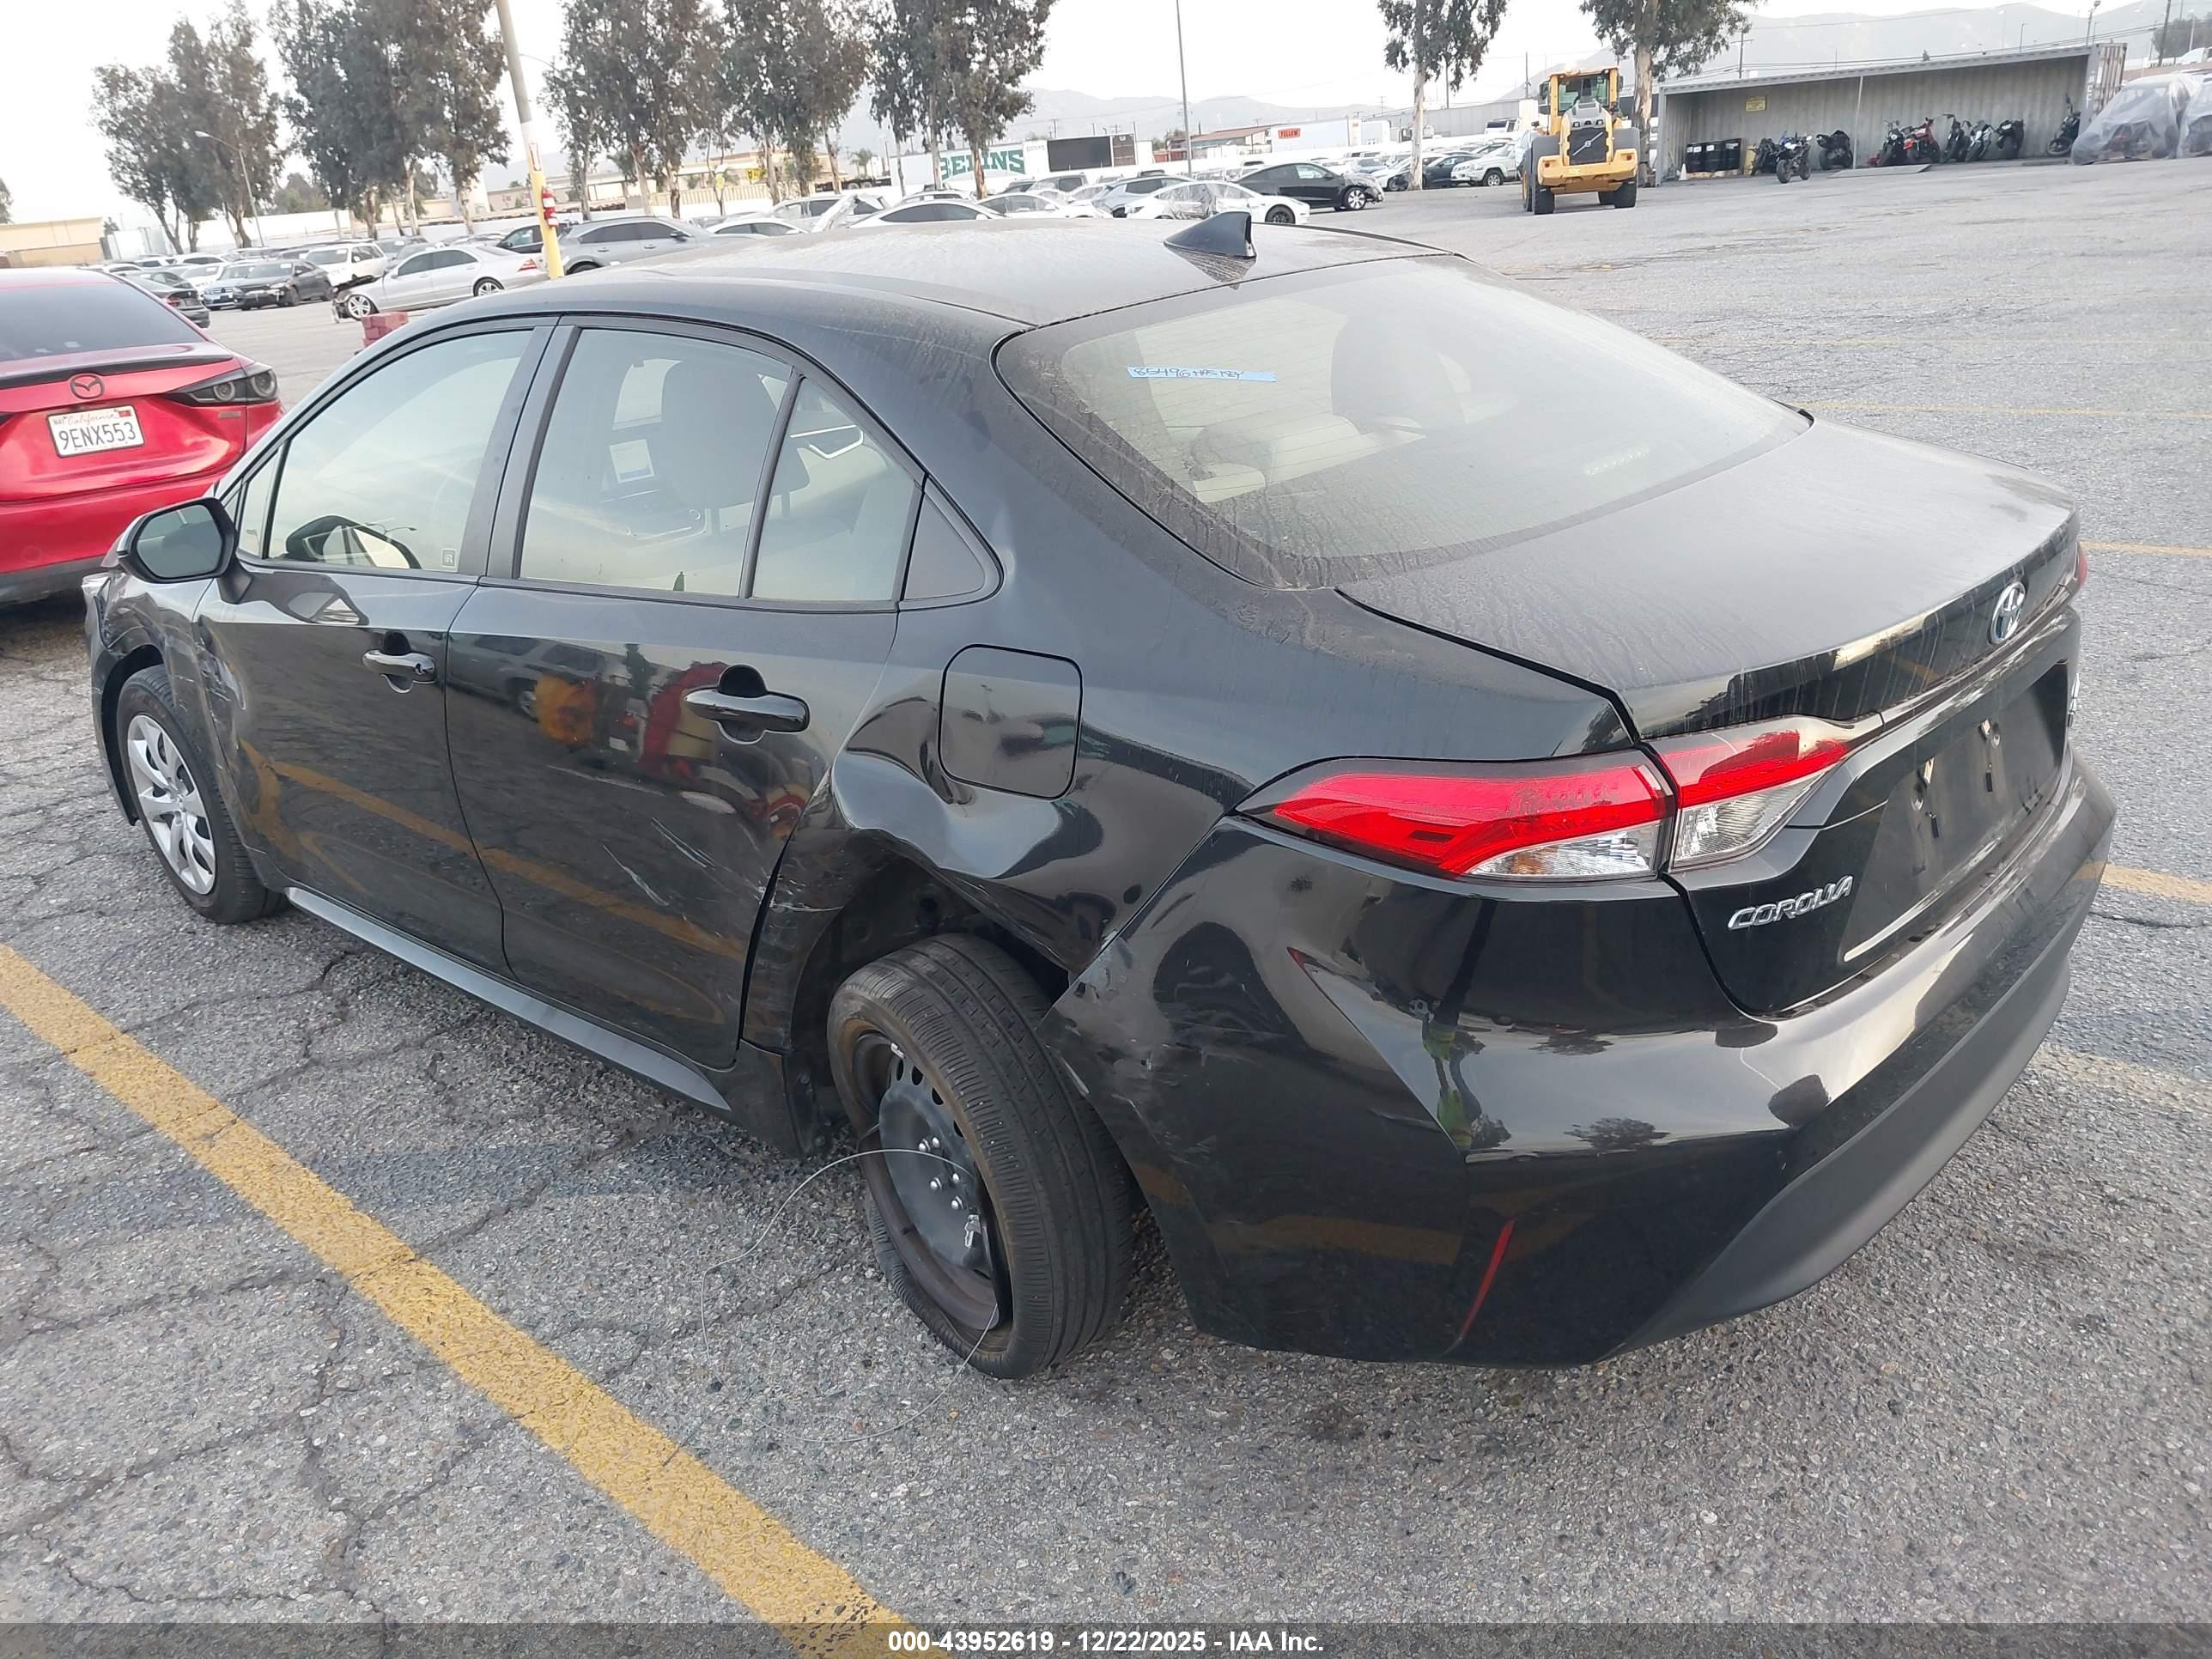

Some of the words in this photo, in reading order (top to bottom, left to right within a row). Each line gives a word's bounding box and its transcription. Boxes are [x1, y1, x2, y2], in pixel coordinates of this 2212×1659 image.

[1279, 130, 1299, 138] YELLOW
[1133, 368, 1190, 378] 85496
[1193, 368, 1218, 376] HAS
[1220, 369, 1244, 380] KEY
[58, 422, 137, 451] 9ENX553
[1727, 874, 1854, 931] COROLLA
